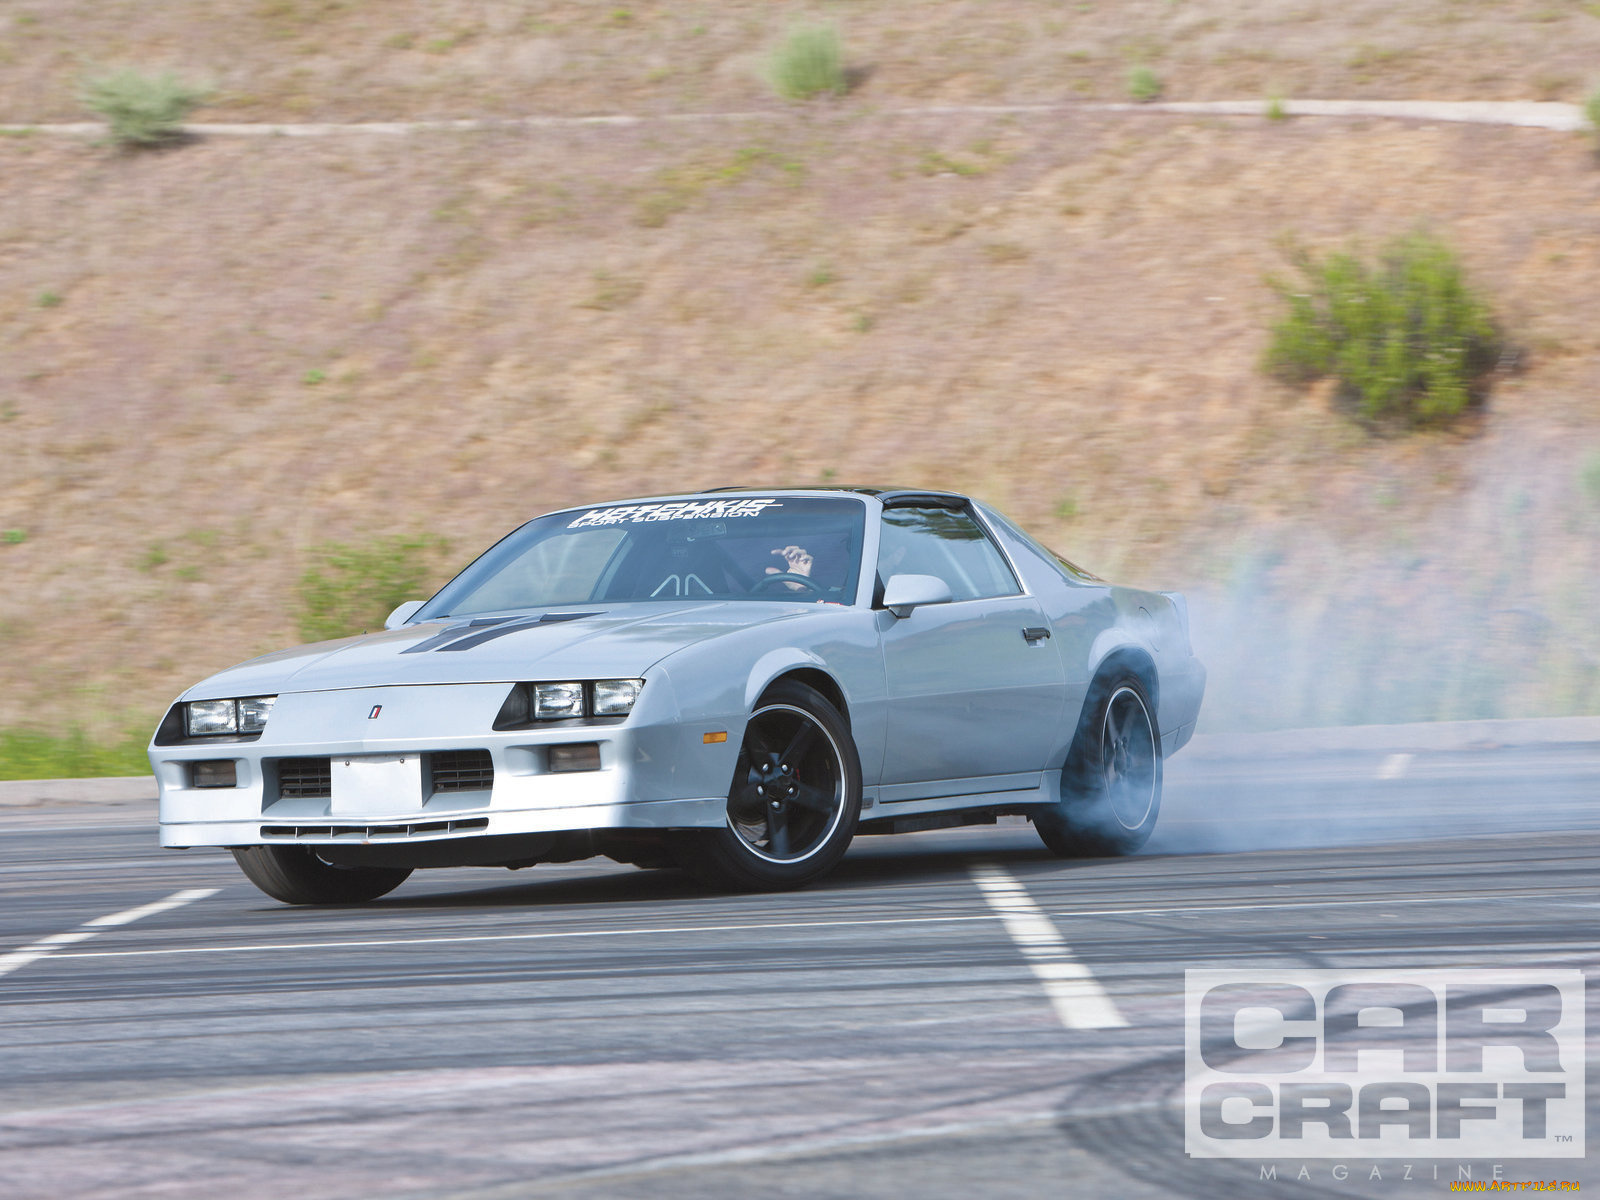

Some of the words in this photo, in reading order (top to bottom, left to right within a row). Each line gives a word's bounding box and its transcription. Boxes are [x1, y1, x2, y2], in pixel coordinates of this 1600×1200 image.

[567, 518, 630, 528] SPORT
[632, 511, 760, 523] SUSPENSION
[573, 499, 782, 523] HOTCHKIS
